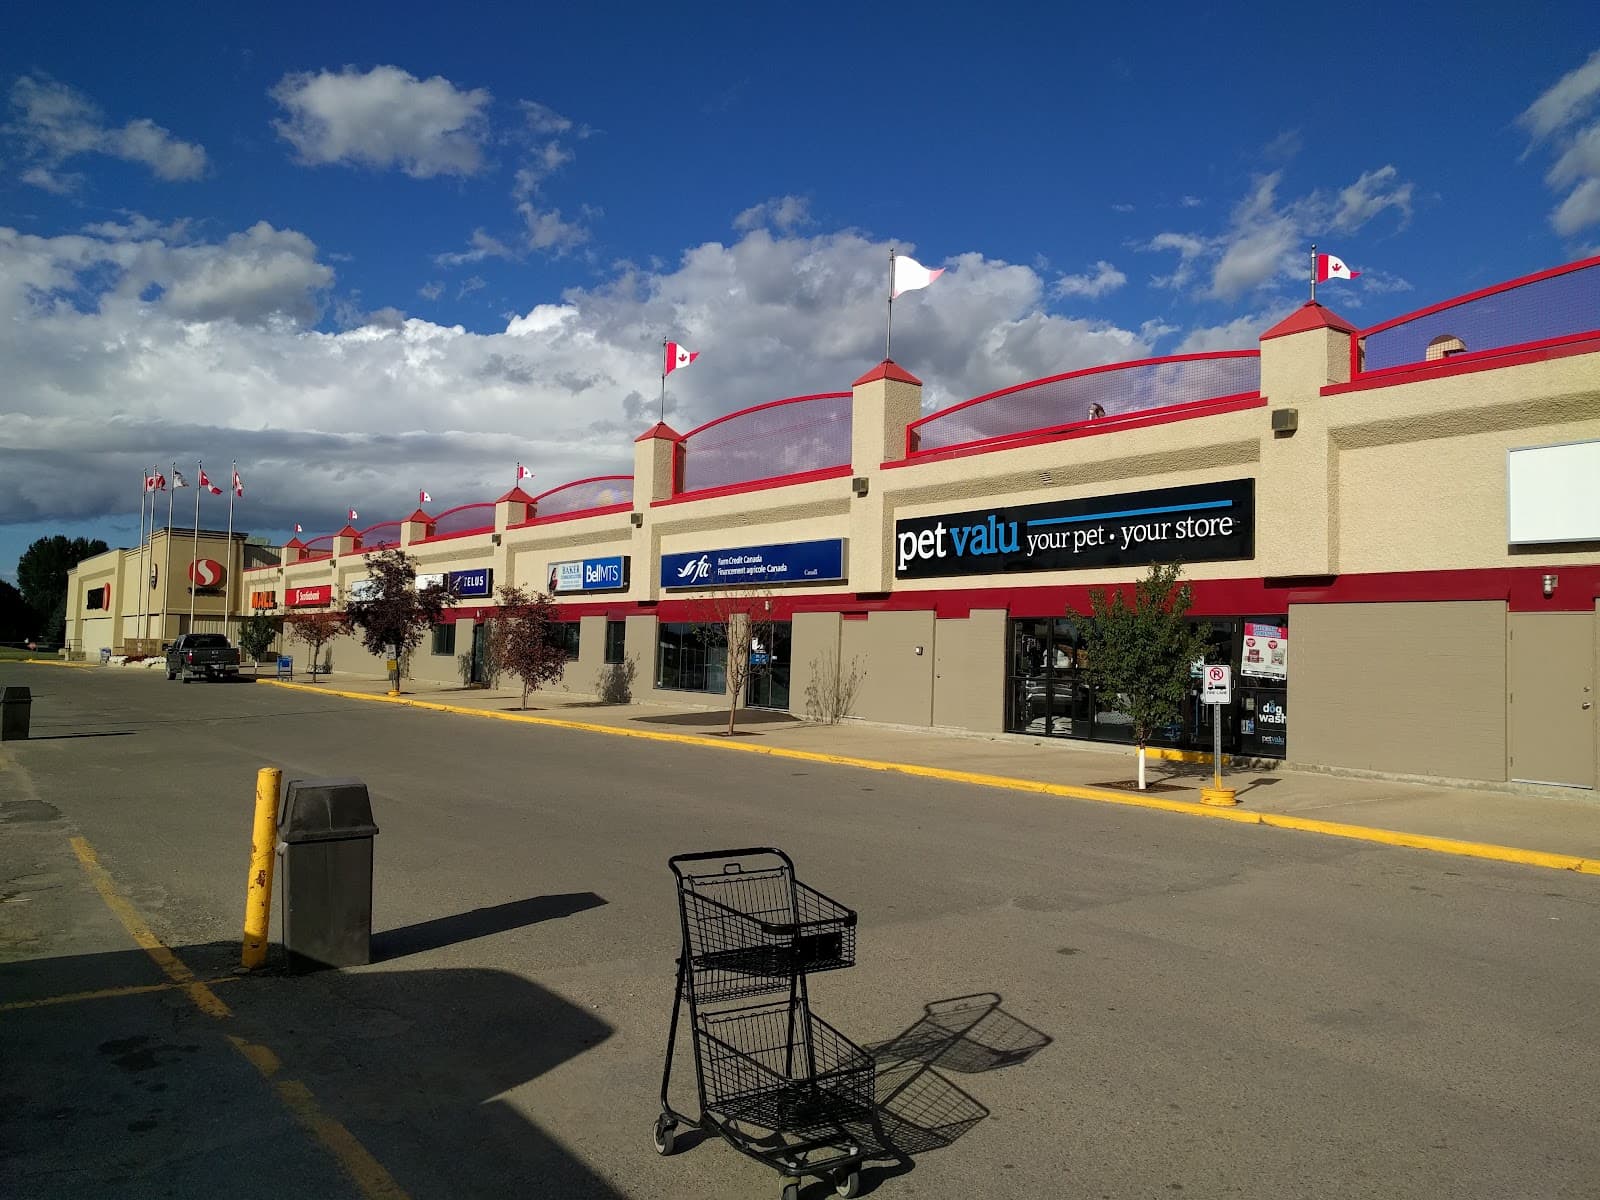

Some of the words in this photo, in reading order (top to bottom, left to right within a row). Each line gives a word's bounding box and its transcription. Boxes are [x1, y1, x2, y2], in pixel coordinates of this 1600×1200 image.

[898, 522, 946, 570] pet
[950, 515, 1020, 557] valu
[1027, 532, 1070, 557] your
[1073, 528, 1105, 553] pet
[1121, 521, 1171, 550] your
[1175, 516, 1233, 539] store
[728, 556, 743, 565] Credit
[743, 554, 762, 564] Canada
[718, 567, 746, 576] Financement
[746, 565, 766, 575] agricole
[767, 563, 787, 573] Canada
[463, 576, 484, 587] TELUS
[252, 591, 273, 608] MALL
[299, 590, 320, 601] Scotiabank
[1263, 703, 1282, 715] dog
[1259, 713, 1287, 724] wash
